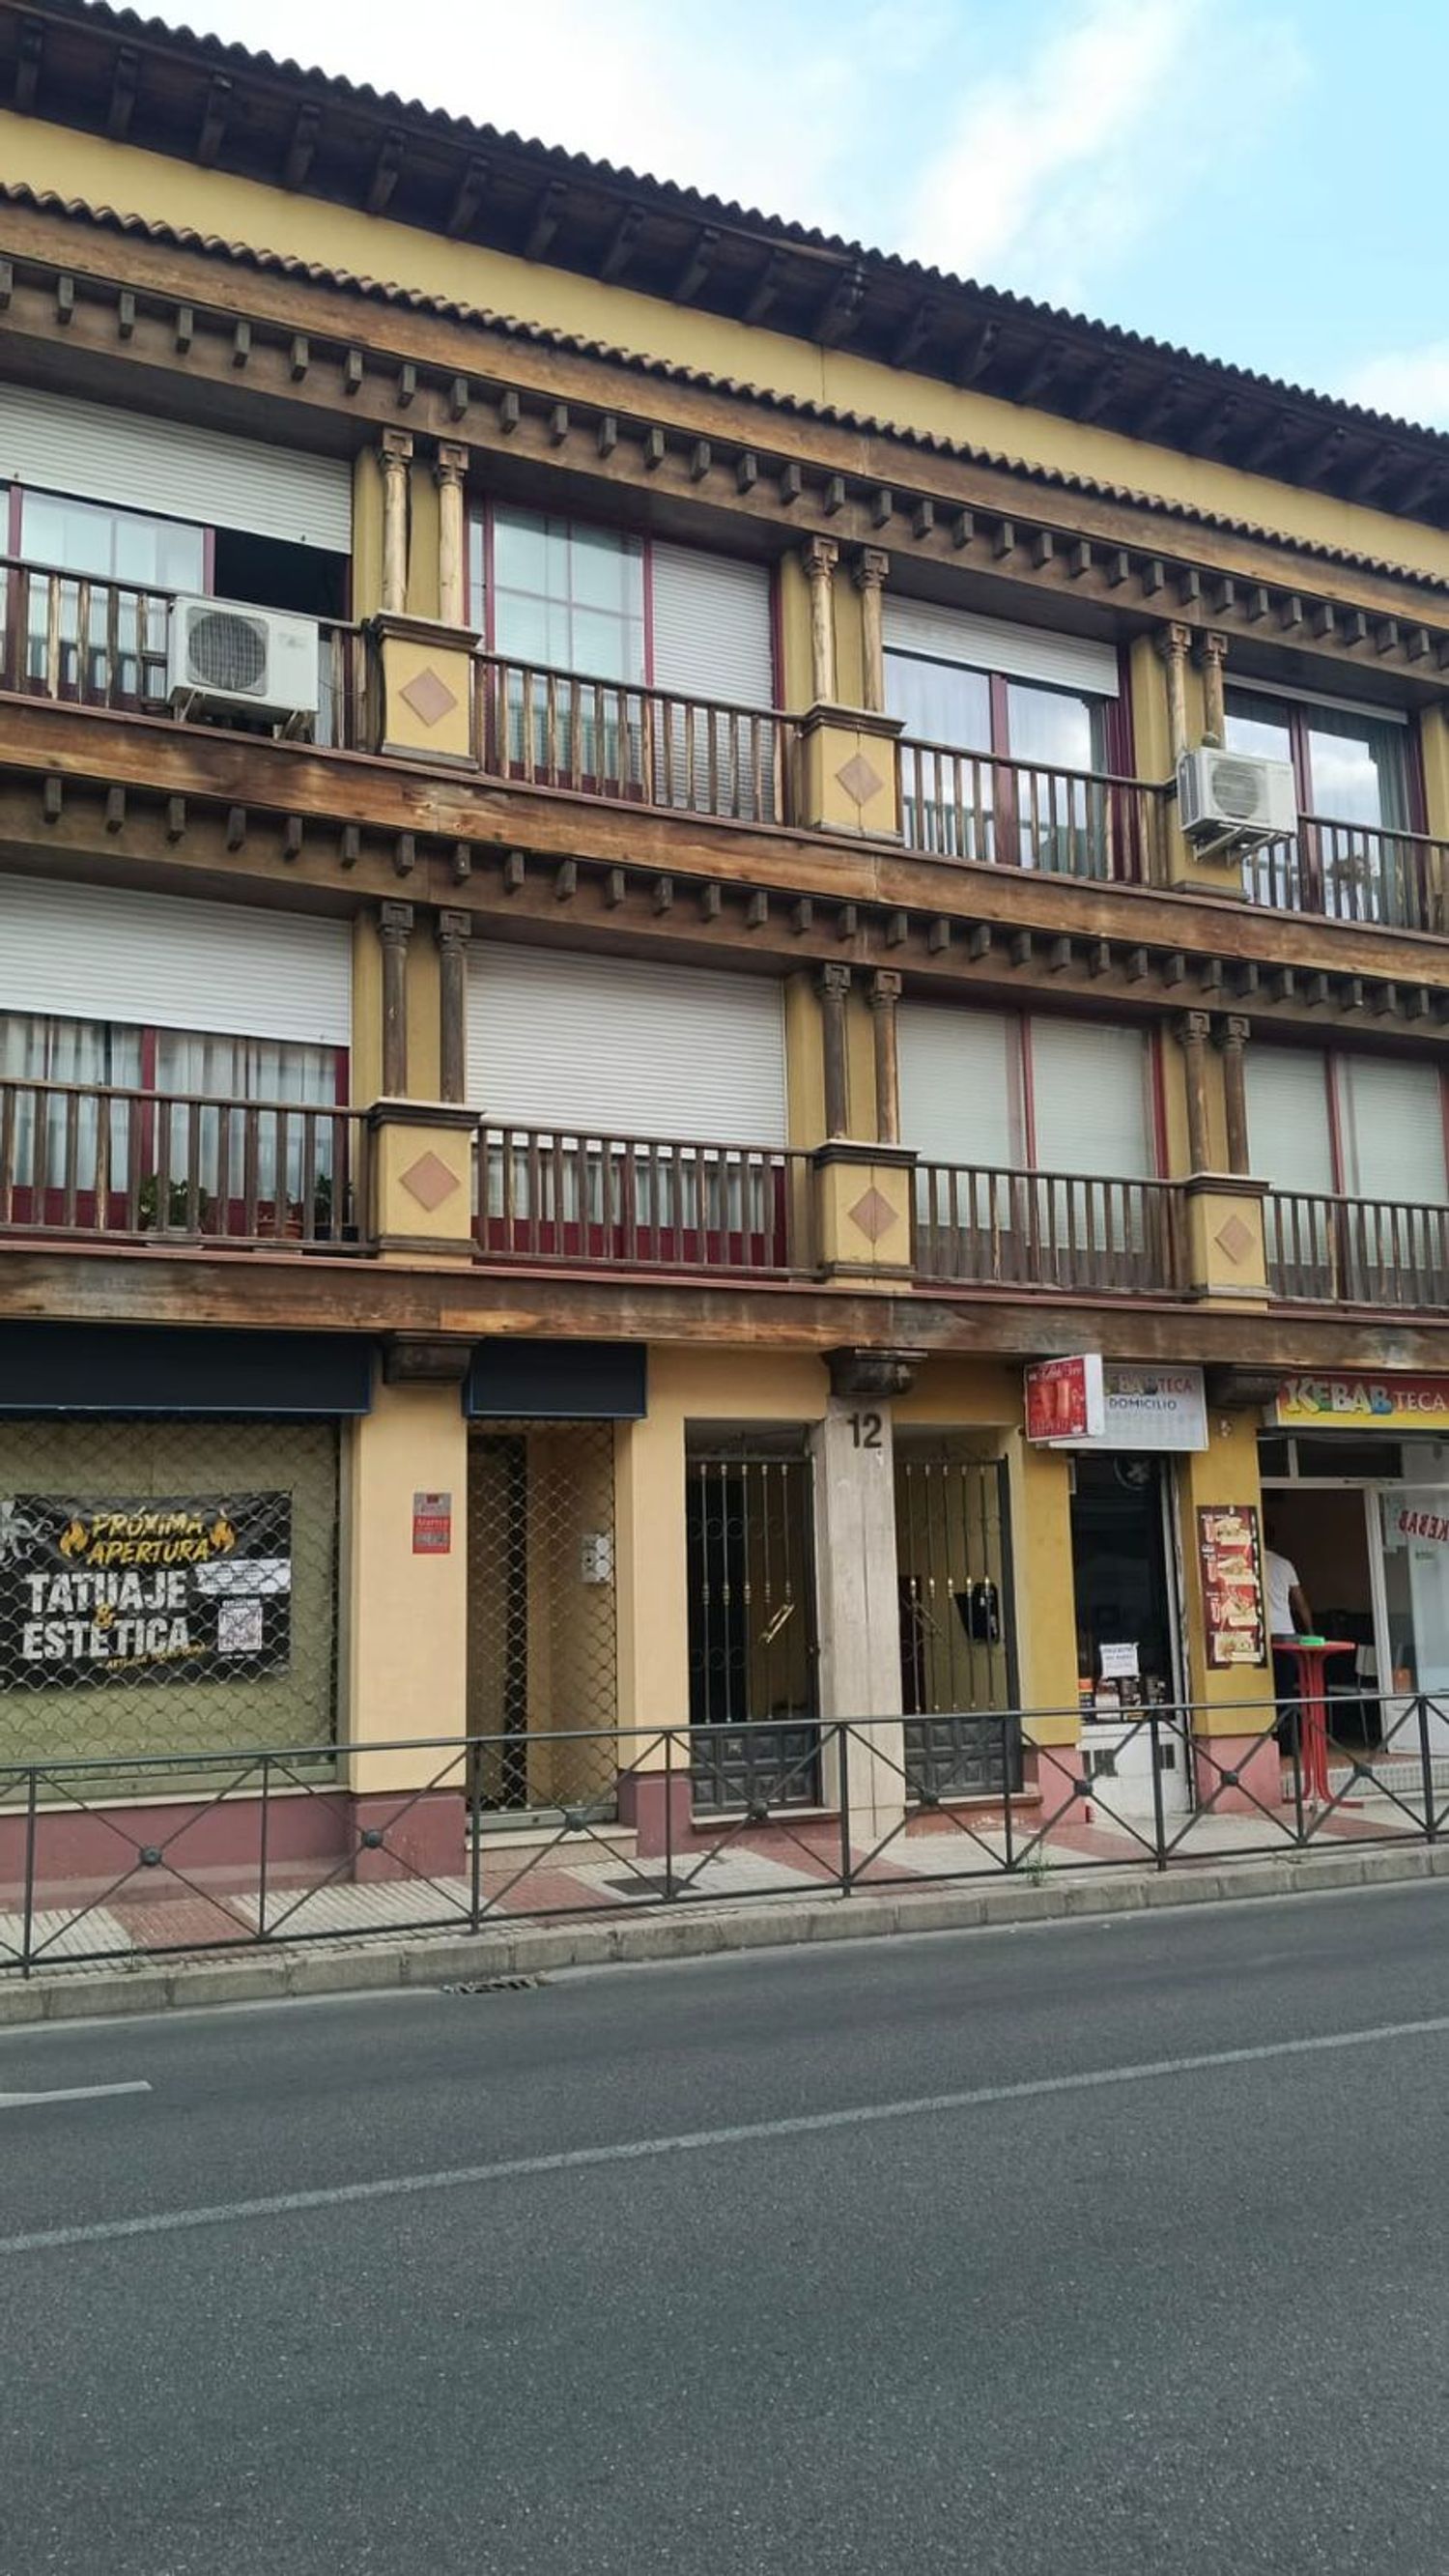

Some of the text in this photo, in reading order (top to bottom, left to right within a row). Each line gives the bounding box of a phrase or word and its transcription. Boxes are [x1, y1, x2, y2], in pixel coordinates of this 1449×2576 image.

[1109, 1397, 1178, 1411] DOMICILIO
[1284, 1375, 1447, 1416] KEBAB TECA
[847, 1413, 882, 1448] 12
[85, 1538, 210, 1564] APERTURA
[25, 1570, 188, 1613] TATUAJE
[94, 1602, 116, 1628] &
